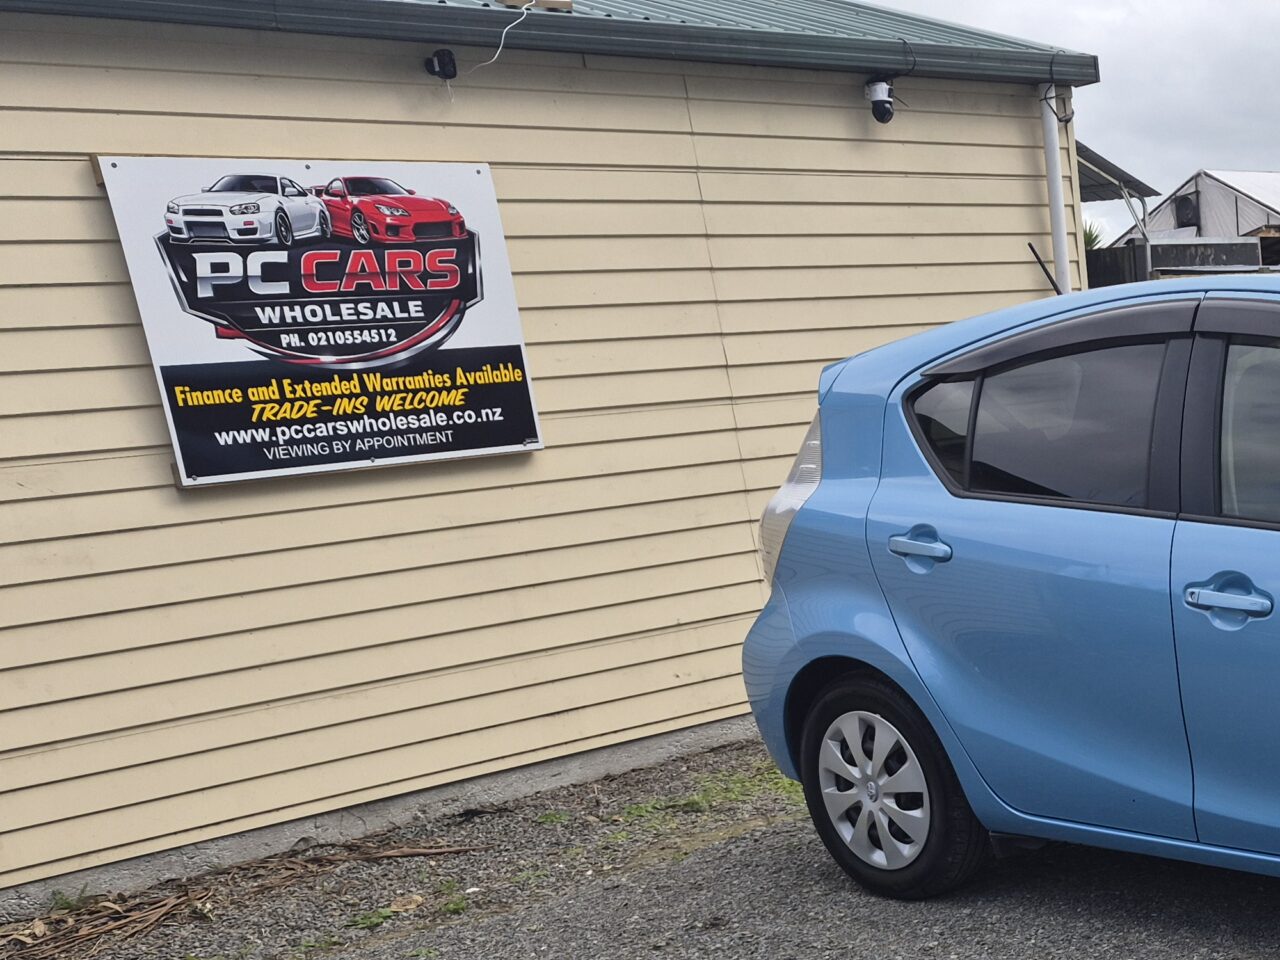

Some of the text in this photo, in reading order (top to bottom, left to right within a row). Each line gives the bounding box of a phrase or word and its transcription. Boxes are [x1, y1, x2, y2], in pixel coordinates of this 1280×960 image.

[192, 248, 461, 298] PC CARS
[254, 300, 425, 324] WHOLESALE
[280, 328, 397, 348] PH. 0210554512
[174, 362, 523, 407] Finance and Extended Warranties Available
[251, 388, 470, 423] TRADE-INS WELCOME
[214, 407, 504, 446] www.pccarswholesale.co.nz
[263, 430, 454, 461] VIEWING BY APPOINTMENT
